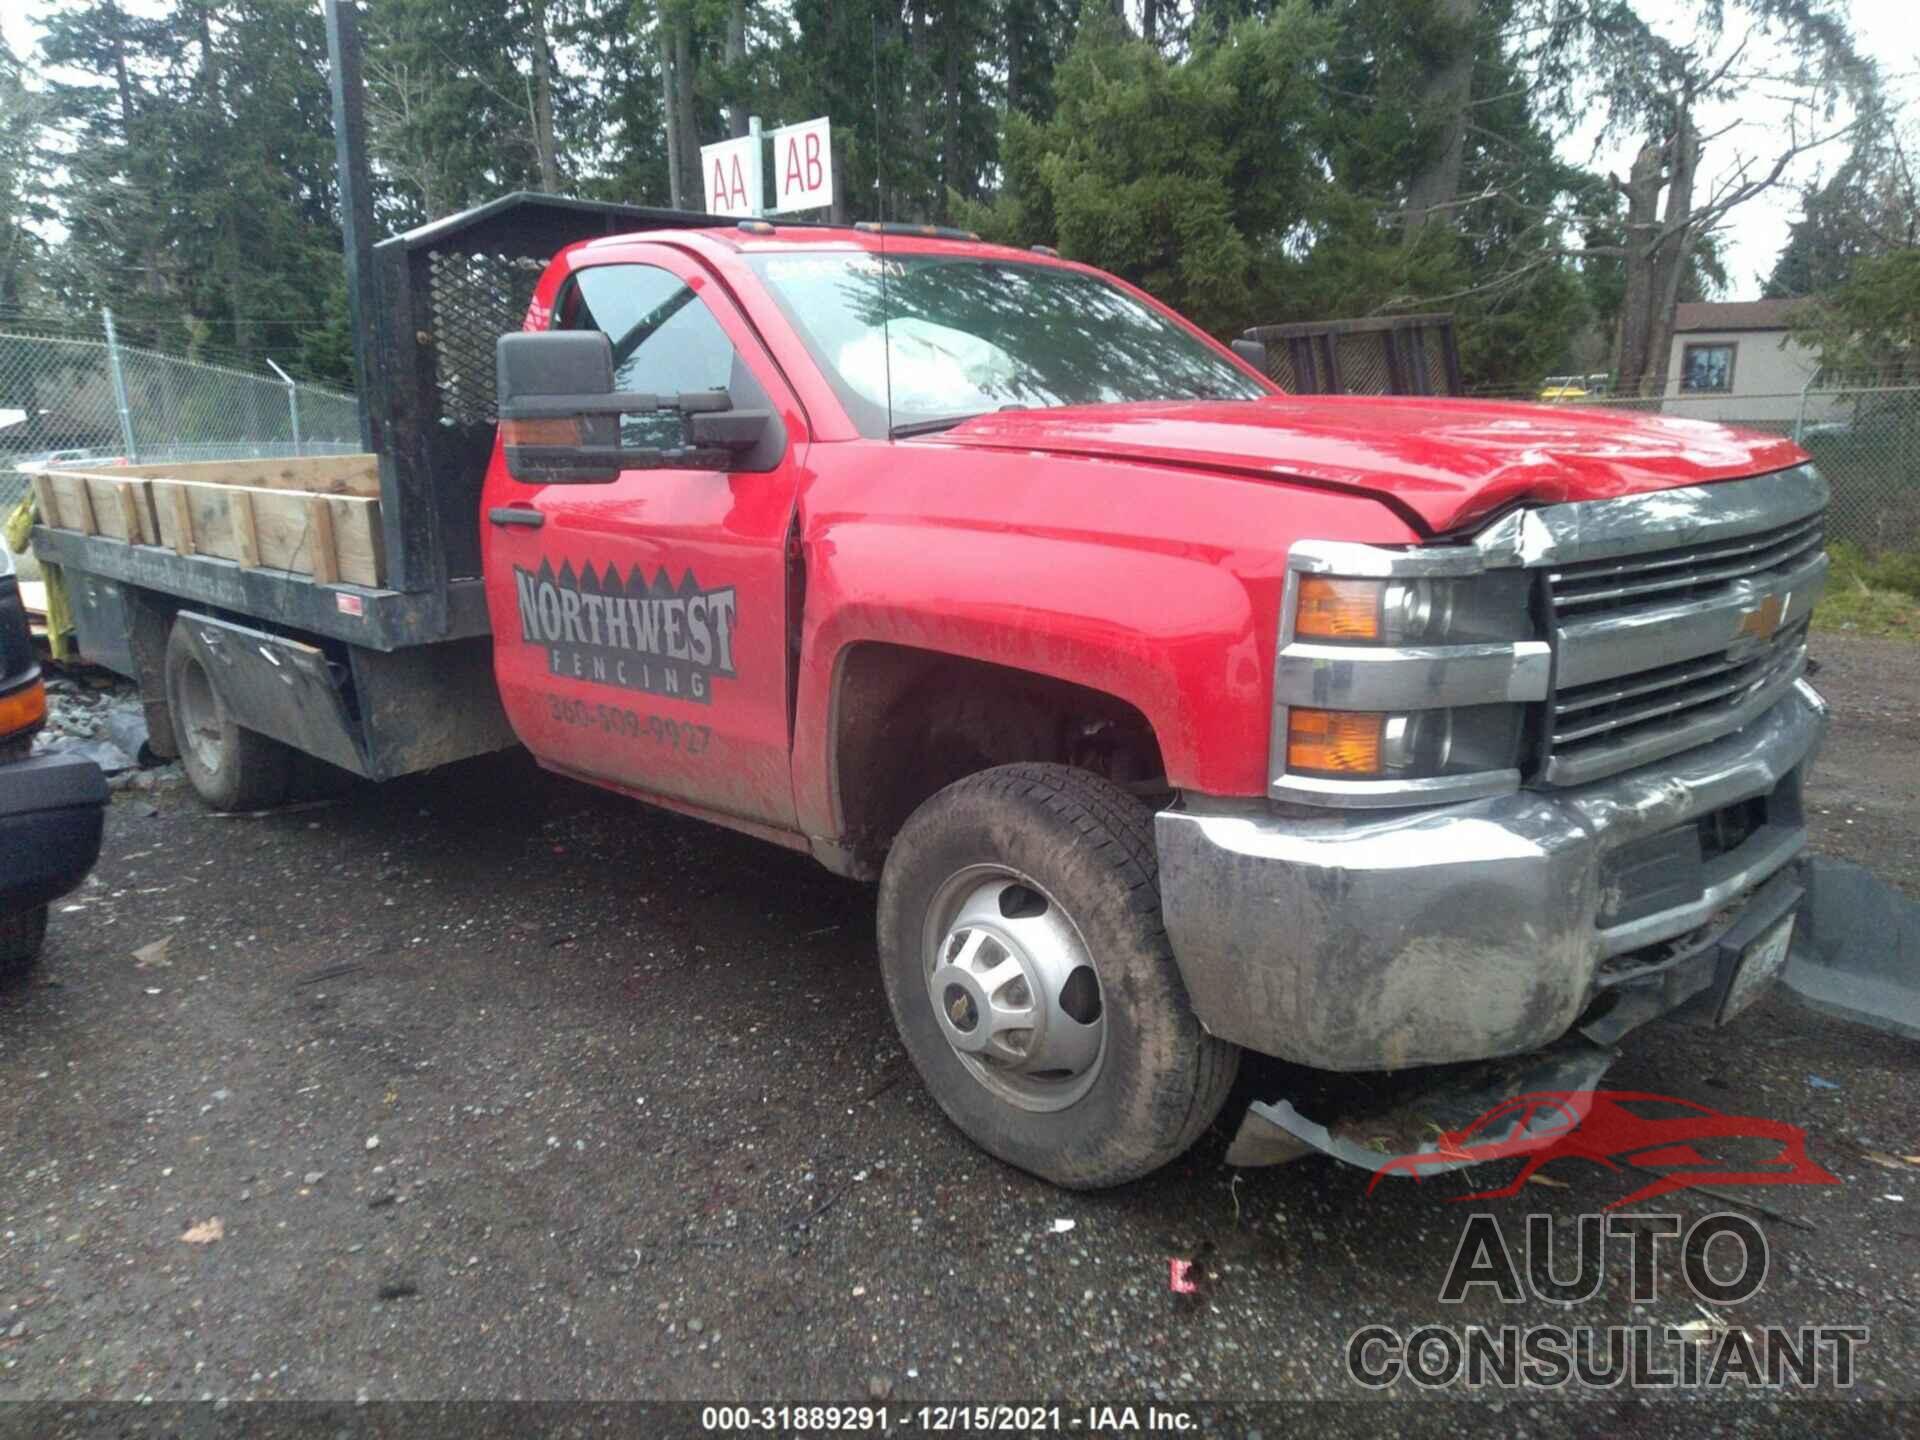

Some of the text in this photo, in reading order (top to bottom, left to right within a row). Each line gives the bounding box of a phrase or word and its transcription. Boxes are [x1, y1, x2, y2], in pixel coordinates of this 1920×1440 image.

[713, 154, 748, 212] AA
[785, 133, 823, 195] AB
[515, 569, 735, 672] NORTHWEST
[552, 651, 705, 697] FENCING
